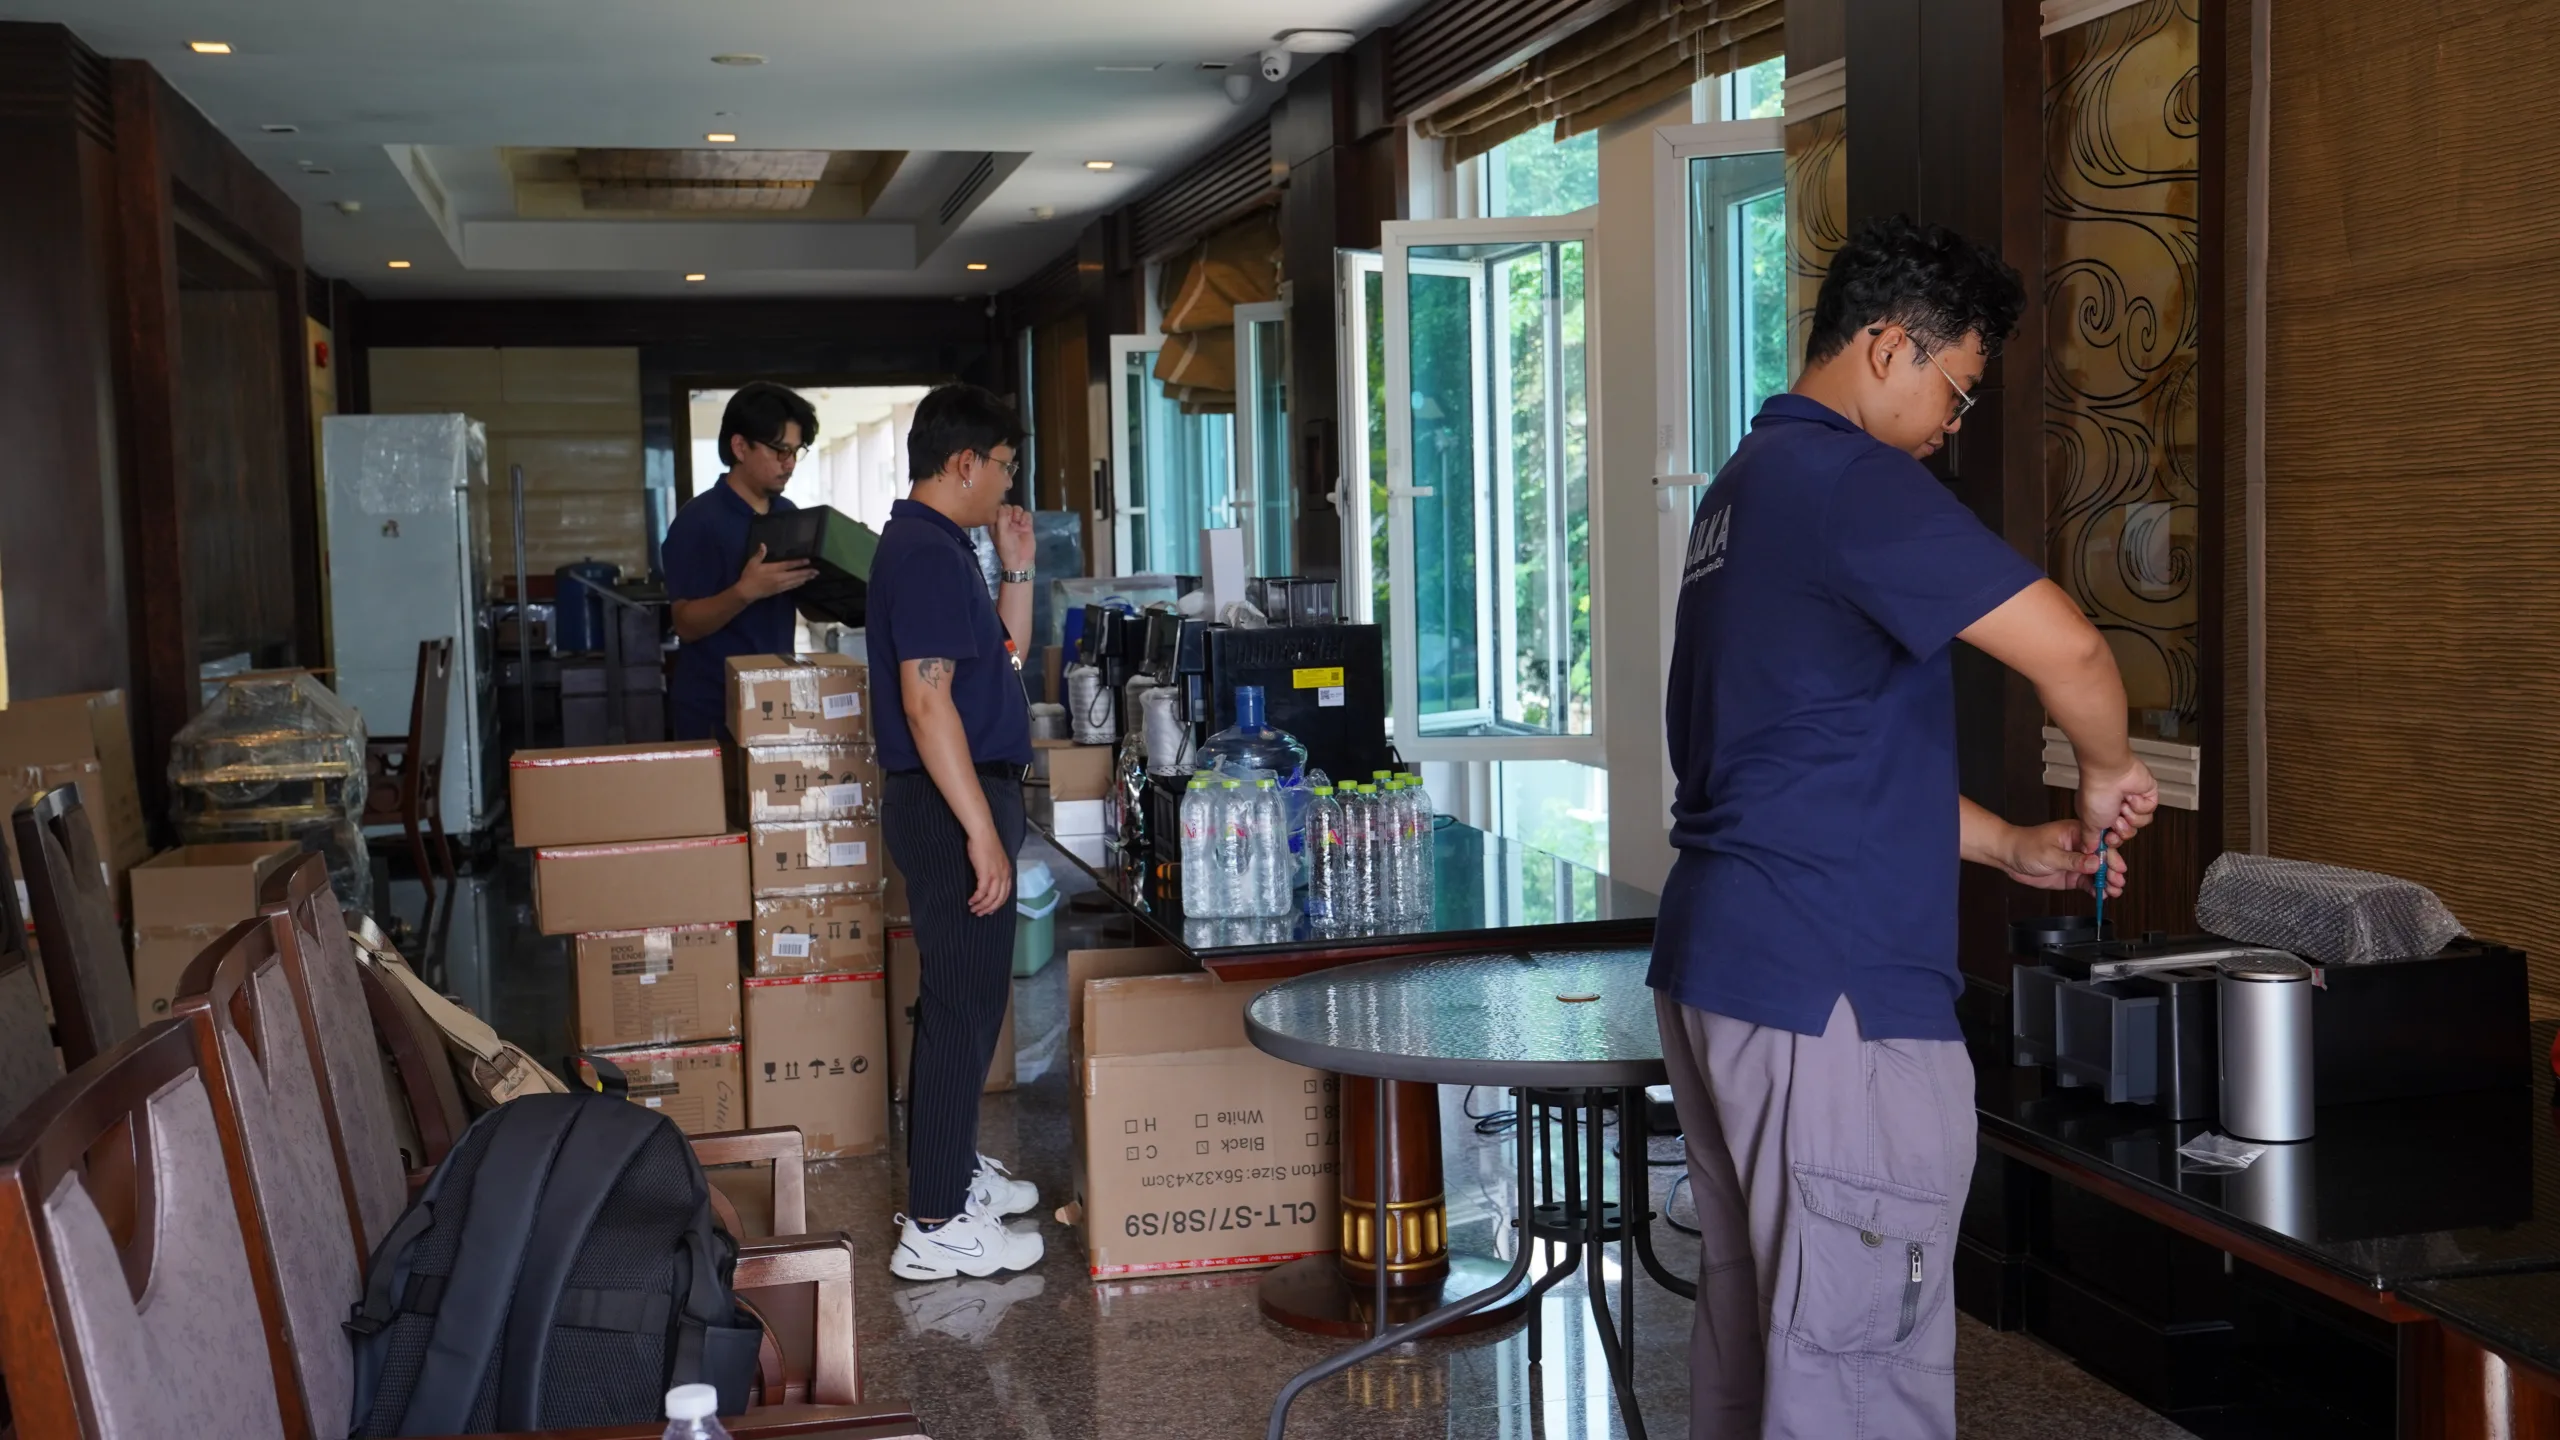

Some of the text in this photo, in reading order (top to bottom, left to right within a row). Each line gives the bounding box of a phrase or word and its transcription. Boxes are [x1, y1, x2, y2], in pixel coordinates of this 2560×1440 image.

[1144, 1117, 1157, 1132] H
[1217, 1109, 1264, 1125] White
[1145, 1144, 1158, 1159] C
[1220, 1136, 1264, 1153] Black
[1125, 1201, 1317, 1238] CLT-S7/S8/S9
